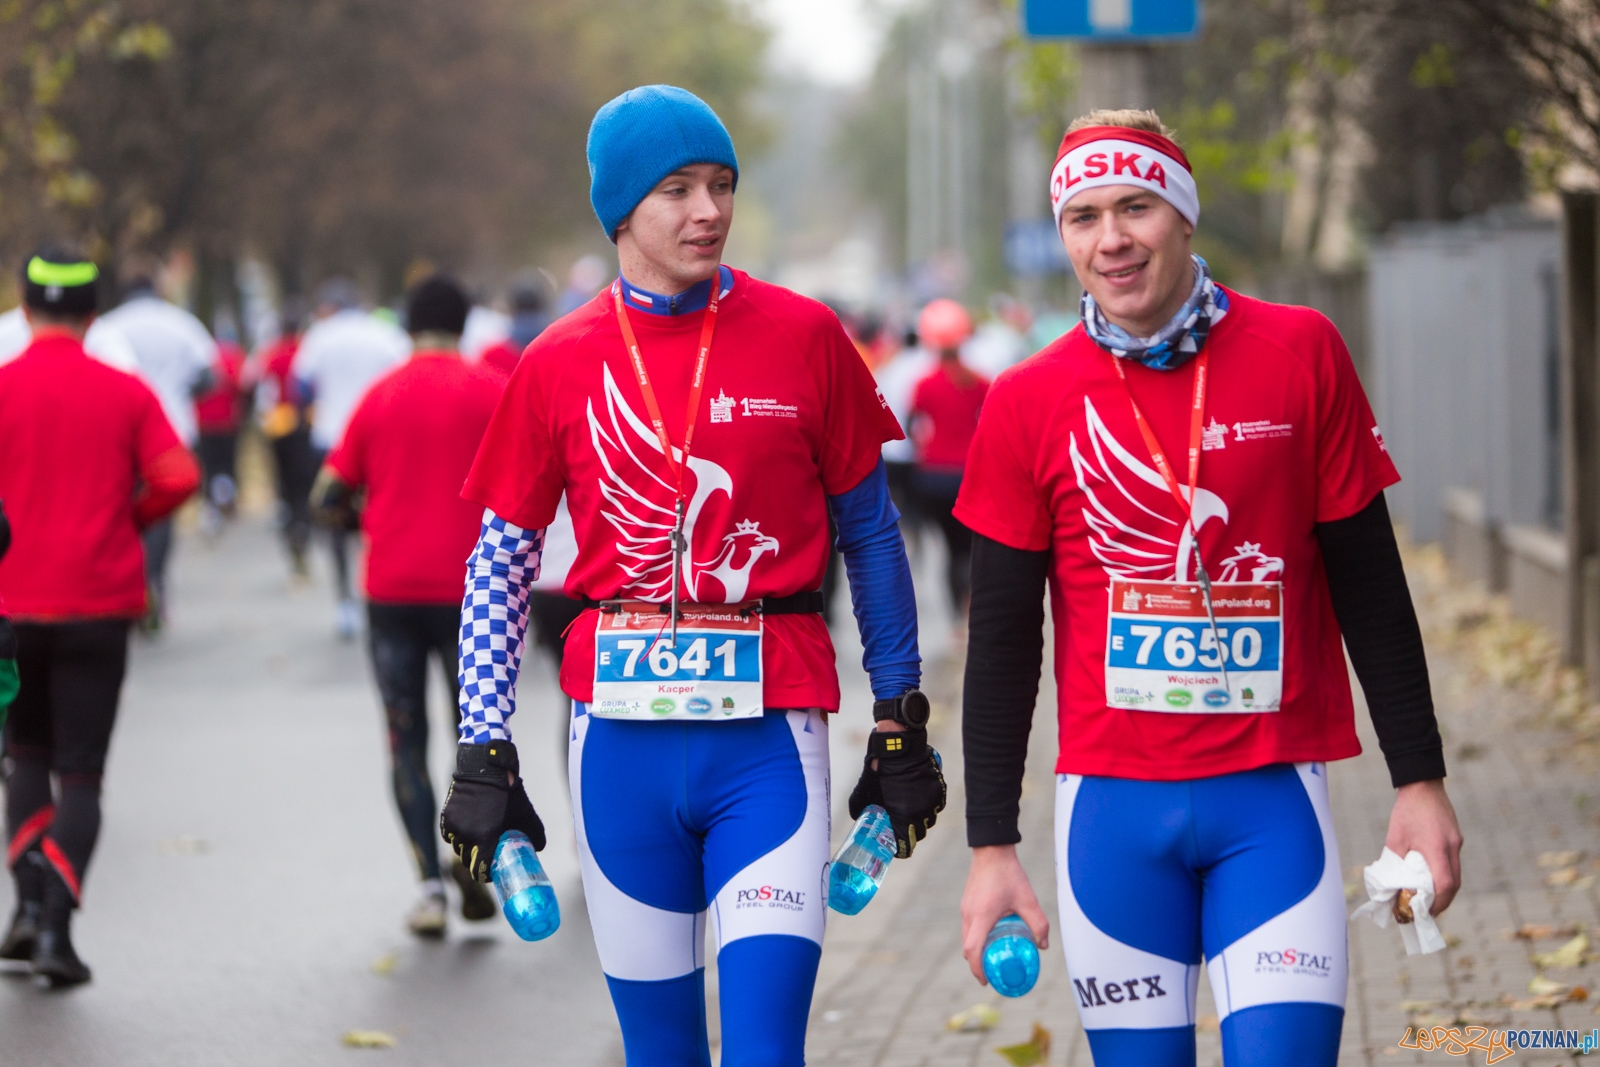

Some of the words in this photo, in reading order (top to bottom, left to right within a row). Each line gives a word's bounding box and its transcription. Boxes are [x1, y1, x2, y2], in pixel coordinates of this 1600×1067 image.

[1051, 151, 1167, 208] OLSKA
[630, 345, 648, 386] RunPoland.org
[693, 347, 708, 388] RunPoland.org
[740, 397, 752, 416] 1
[1232, 422, 1245, 441] 1
[600, 651, 610, 665] E
[617, 638, 736, 677] 7641
[1112, 635, 1124, 650] E
[1130, 624, 1263, 668] 7650
[658, 685, 695, 695] Kacper
[1167, 675, 1219, 685] Wojciech
[737, 885, 805, 906] POSTAL
[768, 902, 804, 912] GROUP
[1257, 948, 1331, 971] POSTAL
[1073, 975, 1167, 1008] Merx
